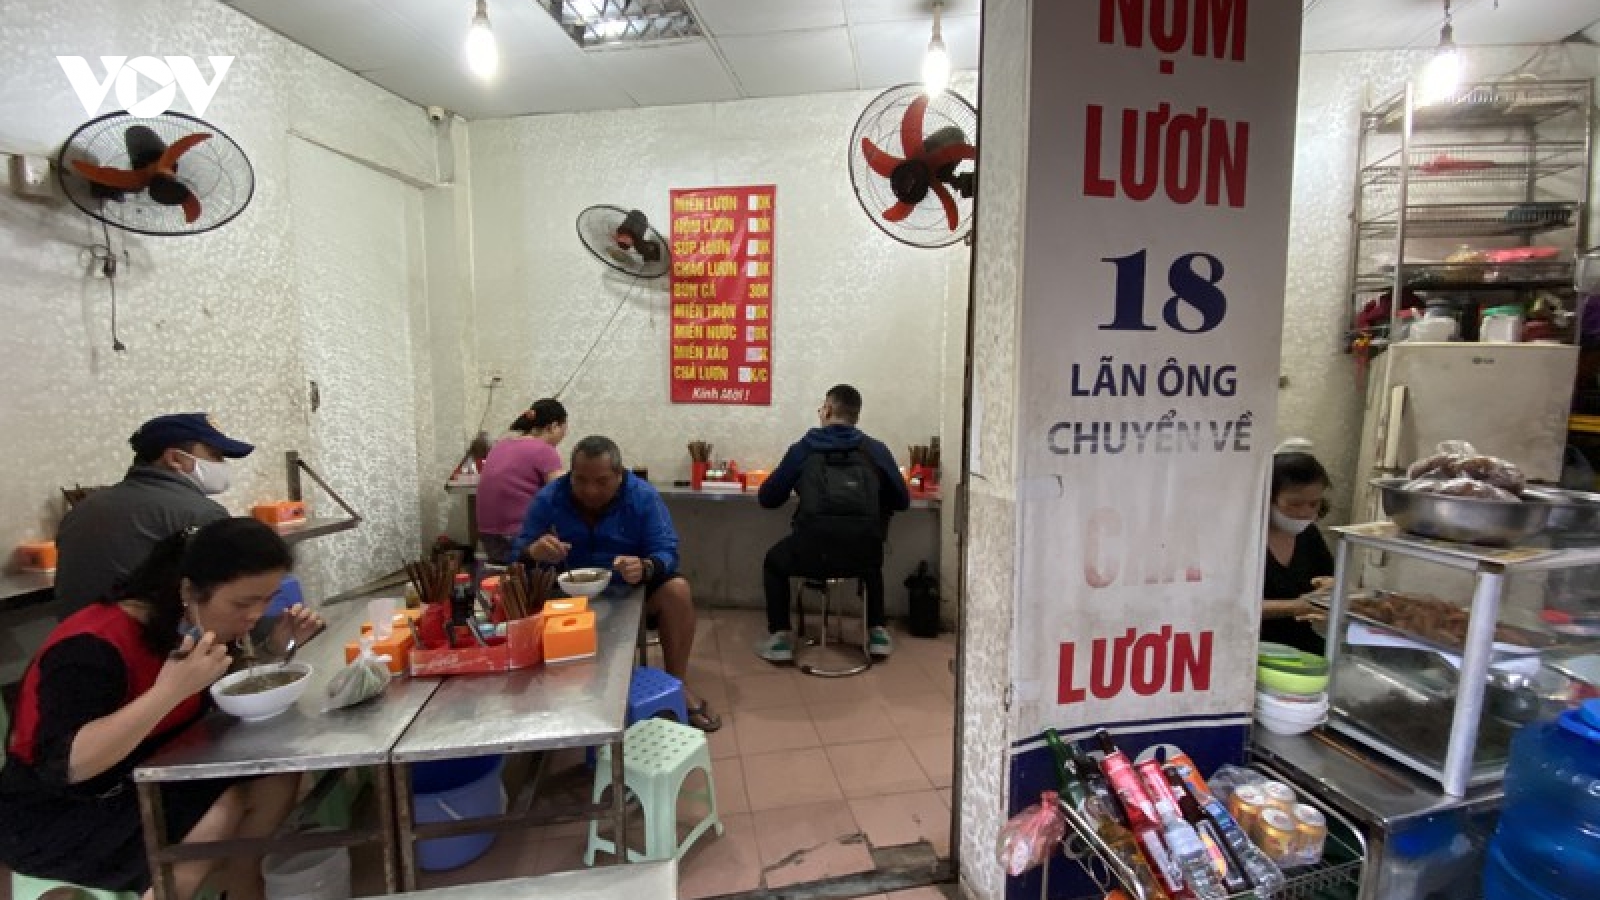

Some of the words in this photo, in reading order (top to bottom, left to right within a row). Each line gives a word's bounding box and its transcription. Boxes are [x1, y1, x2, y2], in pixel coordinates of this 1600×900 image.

[1083, 102, 1249, 208] LƯƠN
[707, 194, 737, 211] LƯƠN
[704, 217, 735, 233] LƯƠN
[700, 239, 731, 255] LƯƠN
[707, 261, 737, 277] LƯƠN
[1098, 248, 1228, 334] 18
[1070, 355, 1147, 397] LÃN
[1157, 357, 1238, 397] ÔNG
[1048, 409, 1202, 454] CHUYỂN
[1209, 409, 1254, 452] VỀ
[1056, 624, 1214, 704] LƯƠN
